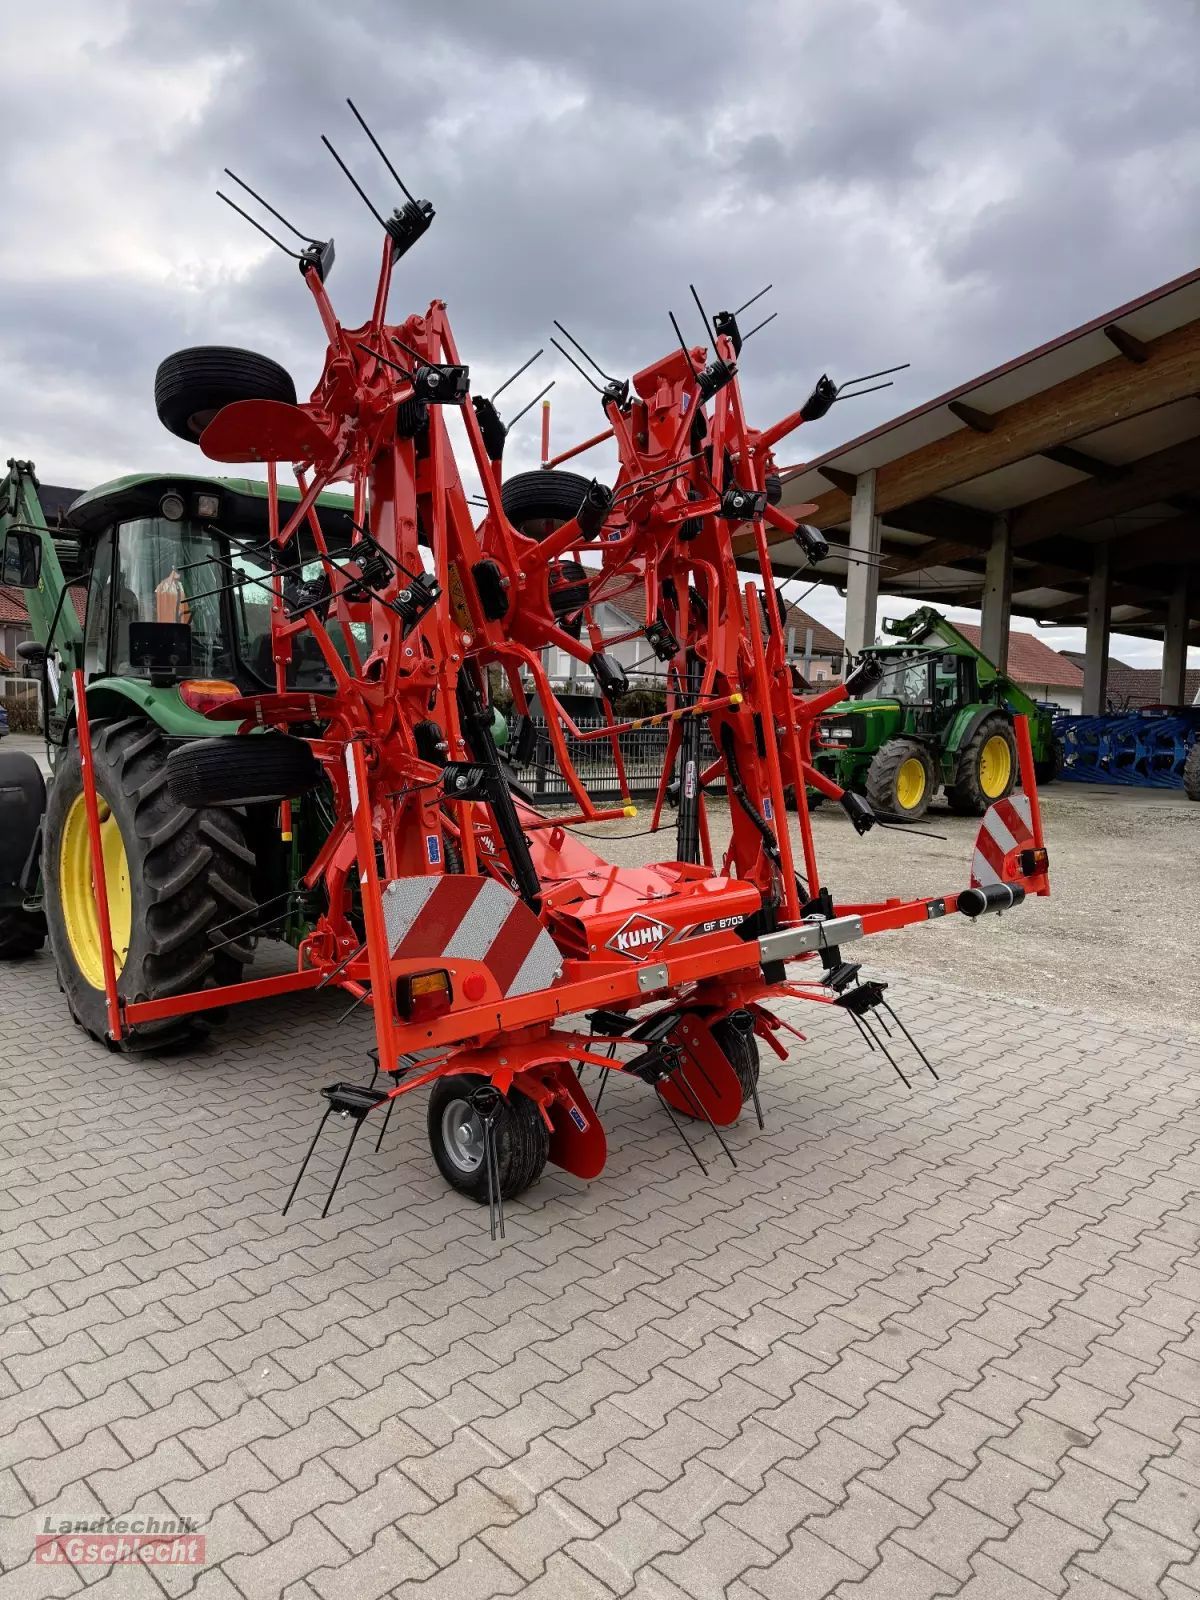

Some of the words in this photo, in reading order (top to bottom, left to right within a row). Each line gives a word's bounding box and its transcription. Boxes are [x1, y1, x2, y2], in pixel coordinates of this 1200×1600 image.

[703, 921, 717, 932] GF
[719, 915, 744, 928] 8703
[617, 924, 664, 950] KUHN
